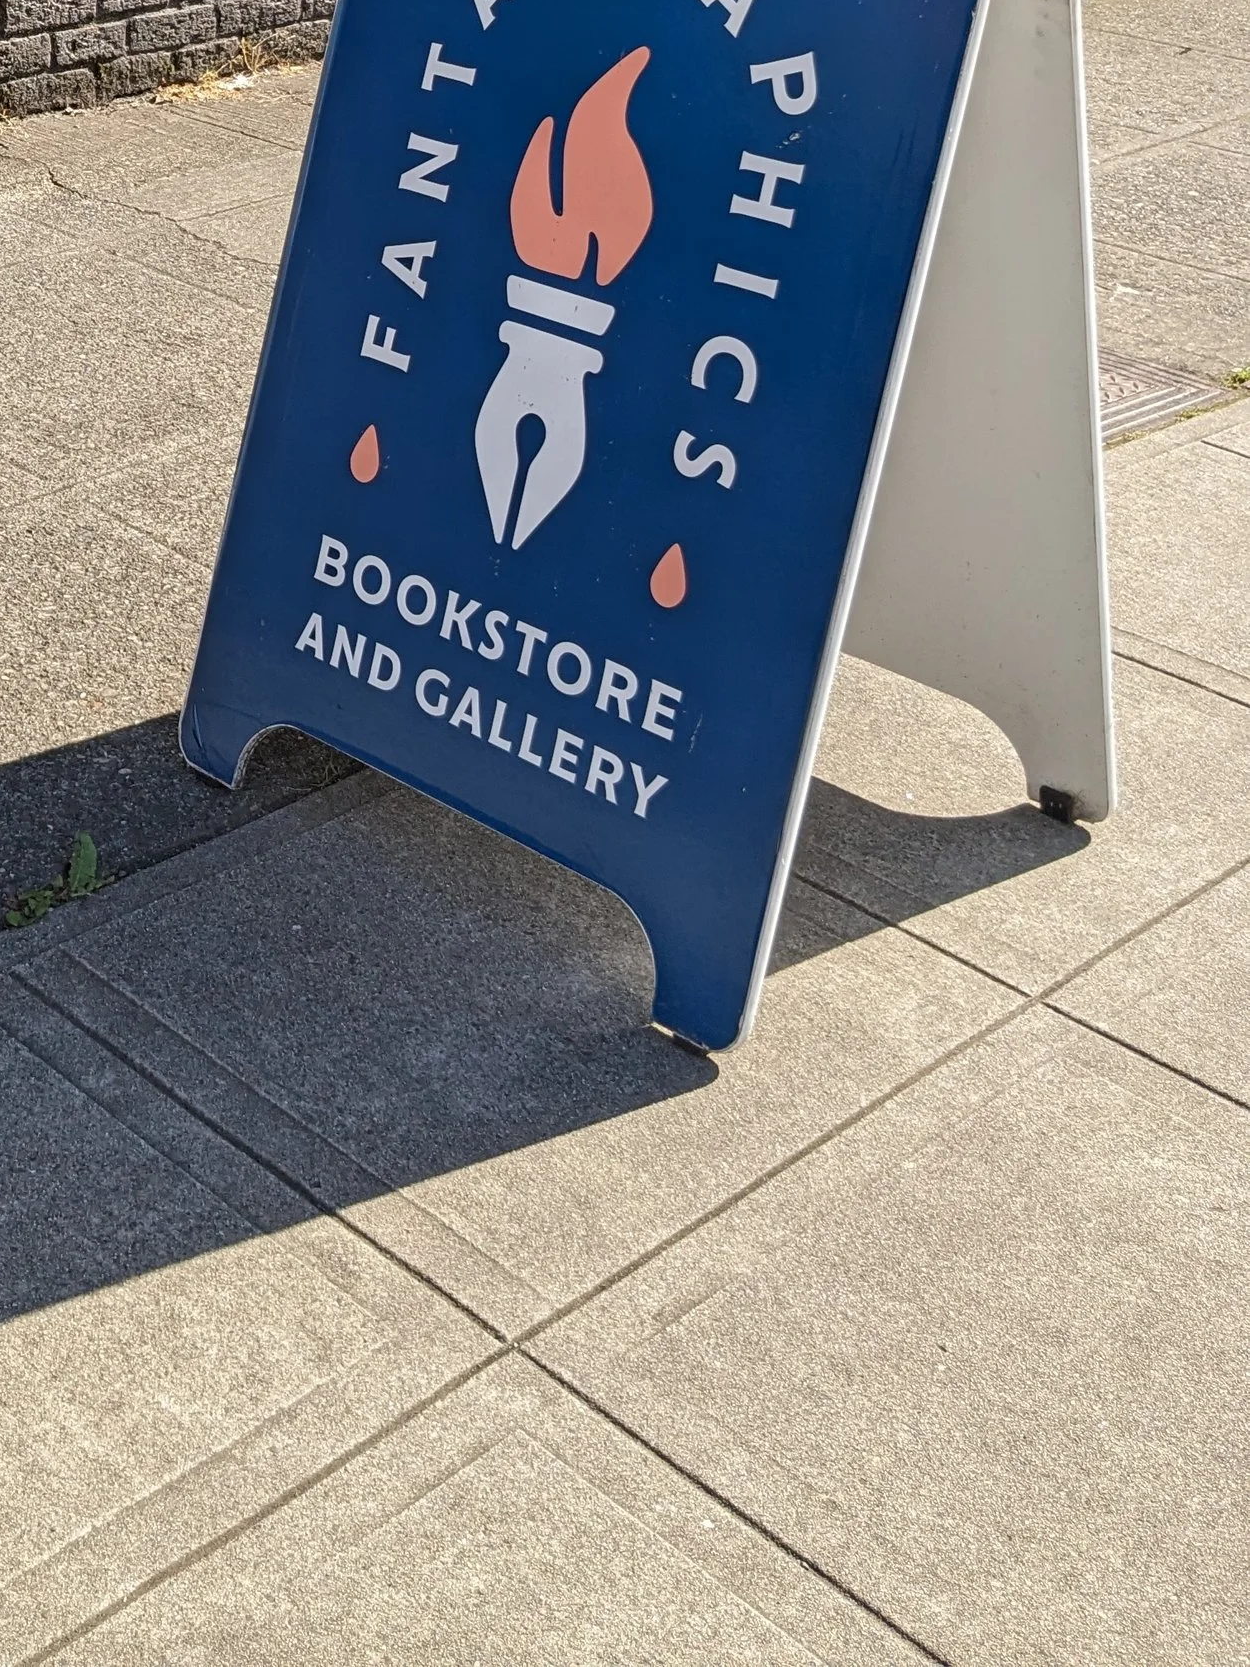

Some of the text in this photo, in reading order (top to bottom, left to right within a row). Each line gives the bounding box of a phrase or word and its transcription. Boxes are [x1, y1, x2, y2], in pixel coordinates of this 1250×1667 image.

[295, 612, 670, 820] AND GALLERY
[313, 534, 683, 742] BOOKSTORE
